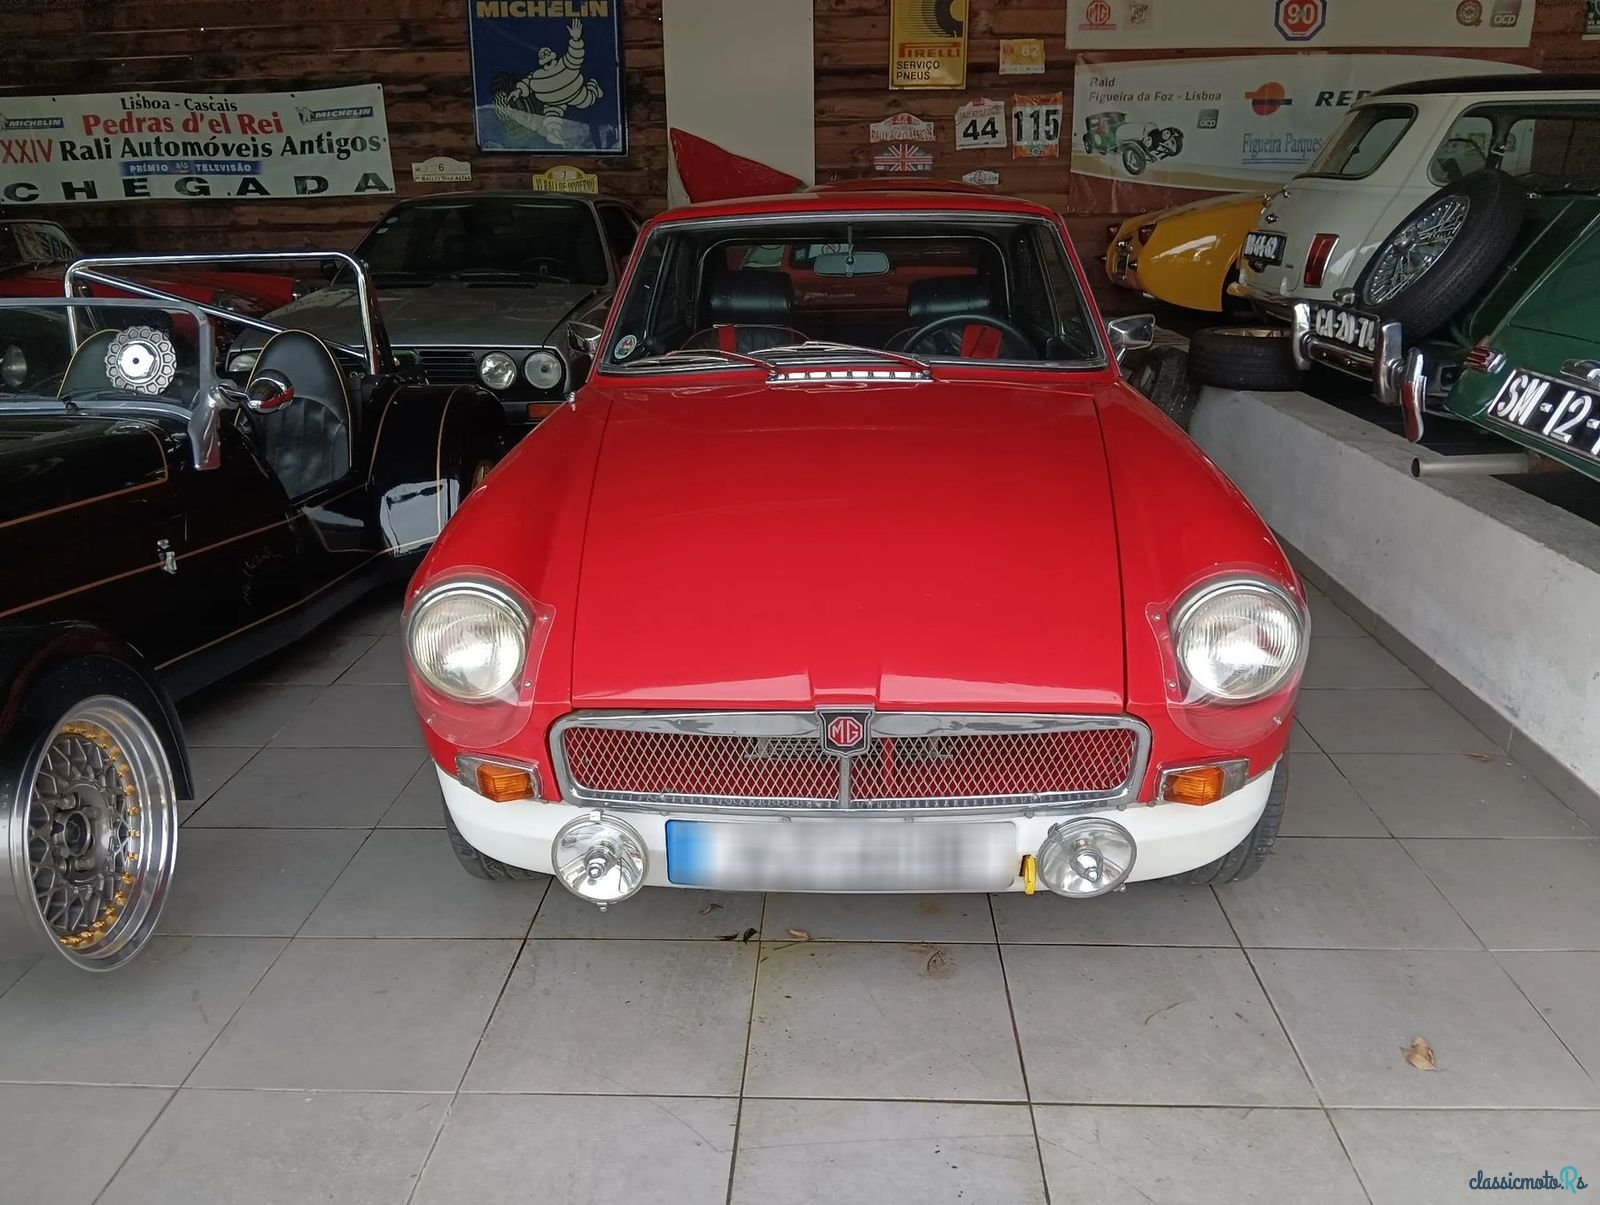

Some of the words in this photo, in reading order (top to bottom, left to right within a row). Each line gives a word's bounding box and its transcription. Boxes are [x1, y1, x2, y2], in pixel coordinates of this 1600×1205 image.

[899, 42, 960, 58] PIRELLI
[896, 60, 940, 70] SERVIÇO
[896, 71, 930, 80] PNEUS
[1090, 77, 1115, 87] Raid
[1089, 92, 1133, 103] Figueira
[1137, 92, 1150, 101] da
[1154, 92, 1174, 101] Foz
[1185, 91, 1222, 101] Lisboa
[121, 97, 170, 110] Lisboa
[184, 99, 237, 112] Cascais
[315, 108, 371, 118] MICHELIN
[9, 119, 61, 127] MICHELIN
[82, 111, 174, 135] Pedras
[182, 112, 231, 134] d'el
[237, 112, 284, 135] Rei
[963, 117, 998, 140] 44
[1014, 109, 1059, 141] 115
[0, 138, 53, 164] XXIV
[60, 137, 112, 161] Rali
[121, 136, 272, 158] Automóveis
[281, 131, 381, 160] Antigos
[1242, 133, 1281, 158] Figueira
[195, 161, 251, 173] TELEVISÃO
[438, 163, 445, 172] 6
[831, 719, 859, 743] MG
